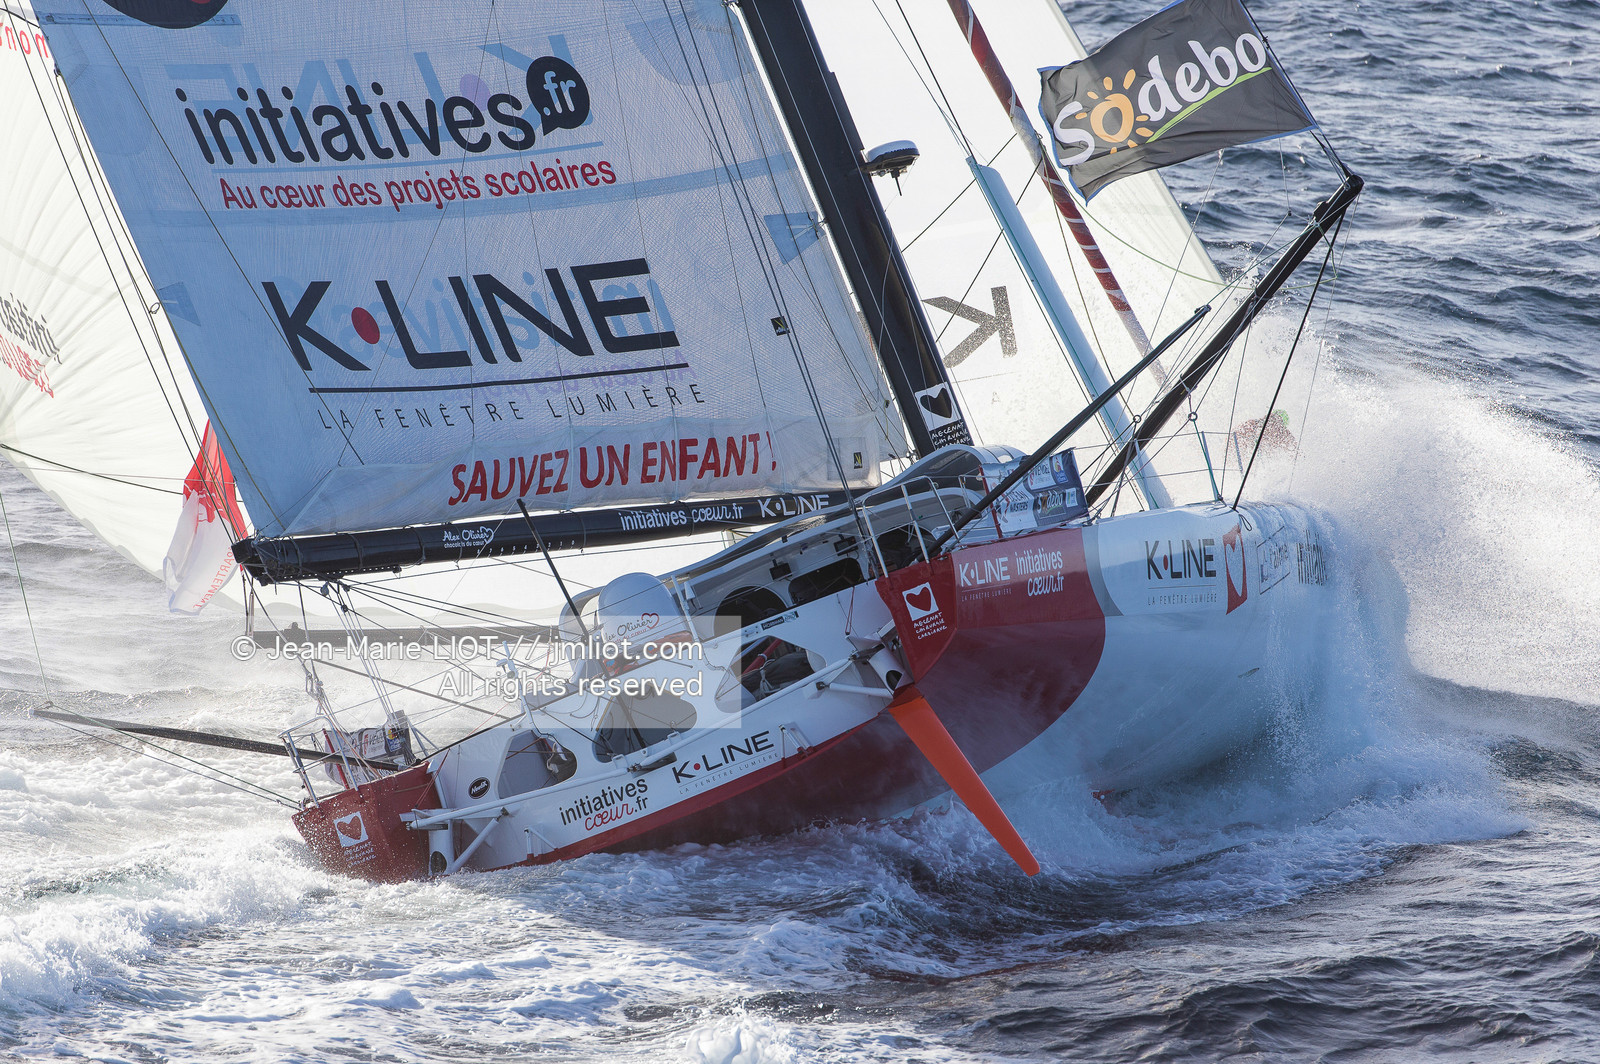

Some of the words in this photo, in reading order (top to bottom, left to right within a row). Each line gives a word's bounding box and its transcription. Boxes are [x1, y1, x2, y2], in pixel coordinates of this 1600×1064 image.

[1054, 33, 1266, 166] Sodebo
[175, 82, 536, 165] initiatives
[220, 178, 257, 209] Au
[260, 184, 326, 209] cœur
[333, 175, 382, 206] des
[385, 169, 481, 212] projets
[485, 158, 617, 197] scolaires
[318, 409, 354, 429] LA
[375, 401, 524, 429] FENÊTRE
[547, 384, 705, 418] LUMIÈRE
[448, 449, 570, 506] SAUVEZ
[580, 443, 631, 487] UN
[640, 433, 761, 484] ENFANT
[442, 530, 460, 542] Alex
[619, 510, 688, 531] initiatives
[1015, 548, 1063, 576] initiatives
[558, 778, 649, 826] initiatives
[679, 787, 690, 795] LA
